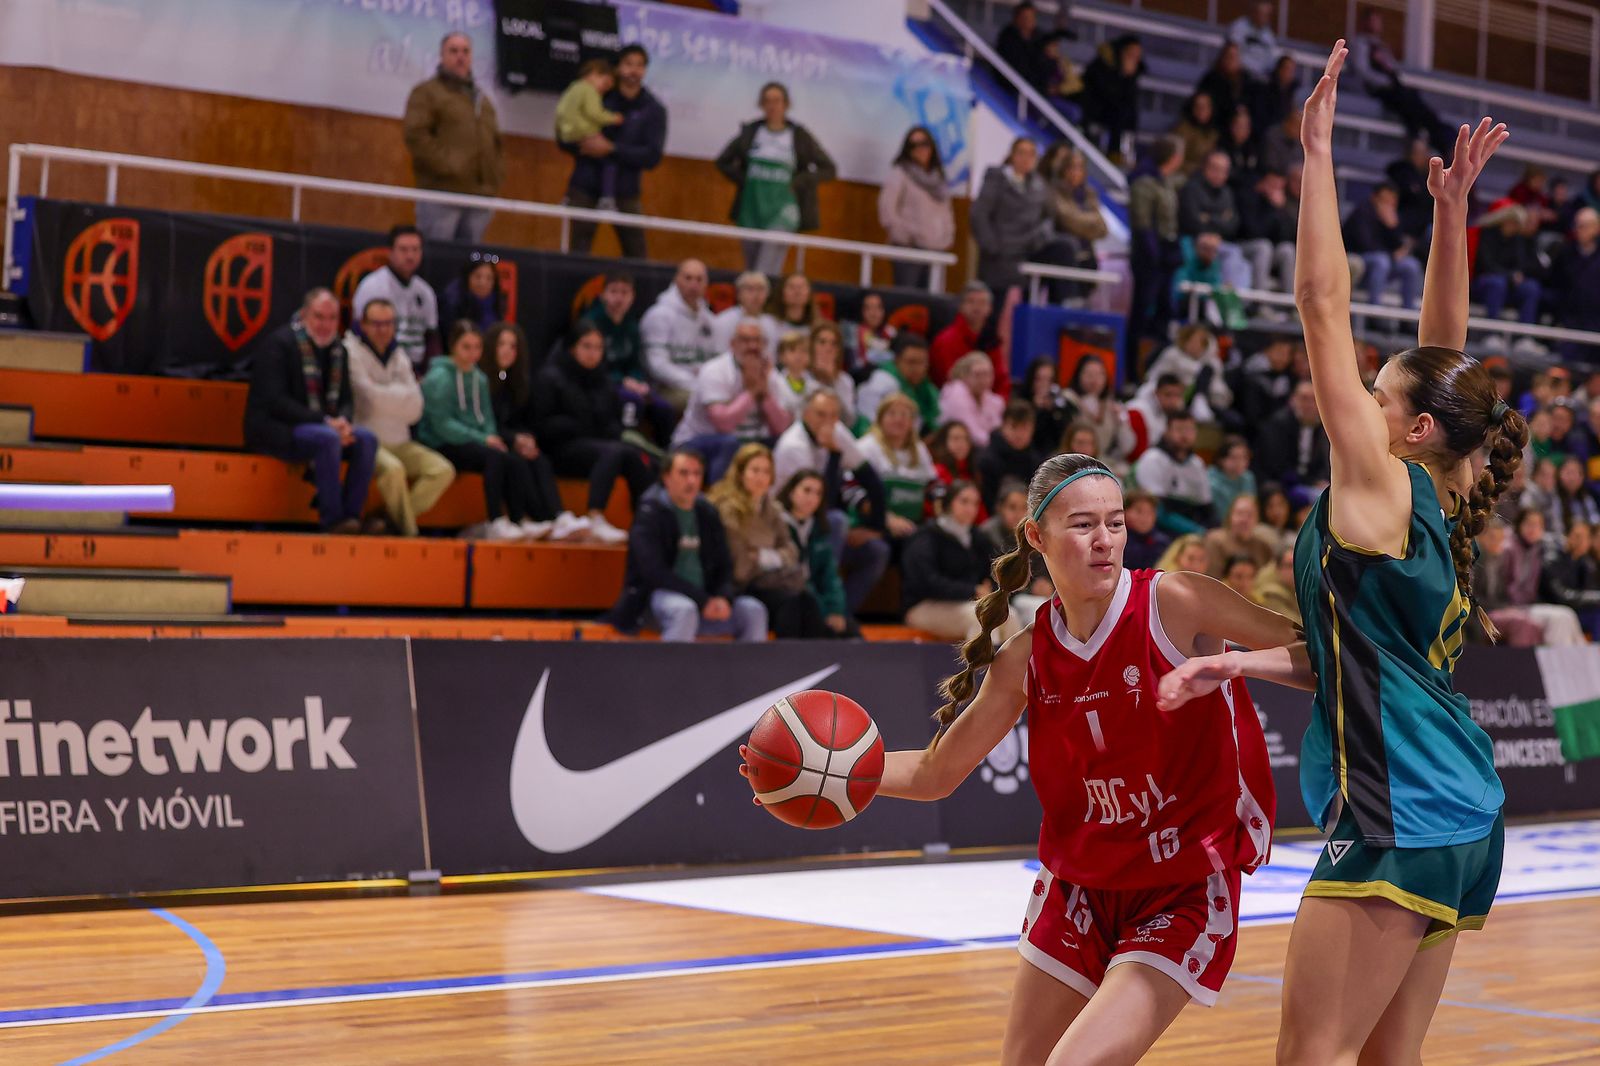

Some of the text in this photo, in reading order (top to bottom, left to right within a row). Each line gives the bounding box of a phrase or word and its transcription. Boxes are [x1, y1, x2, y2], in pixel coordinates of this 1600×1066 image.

[502, 17, 547, 40] LOCAL
[0, 695, 357, 777] finetwork
[0, 786, 244, 834] FIBRA Y MÓVIL
[1147, 827, 1180, 863] 13
